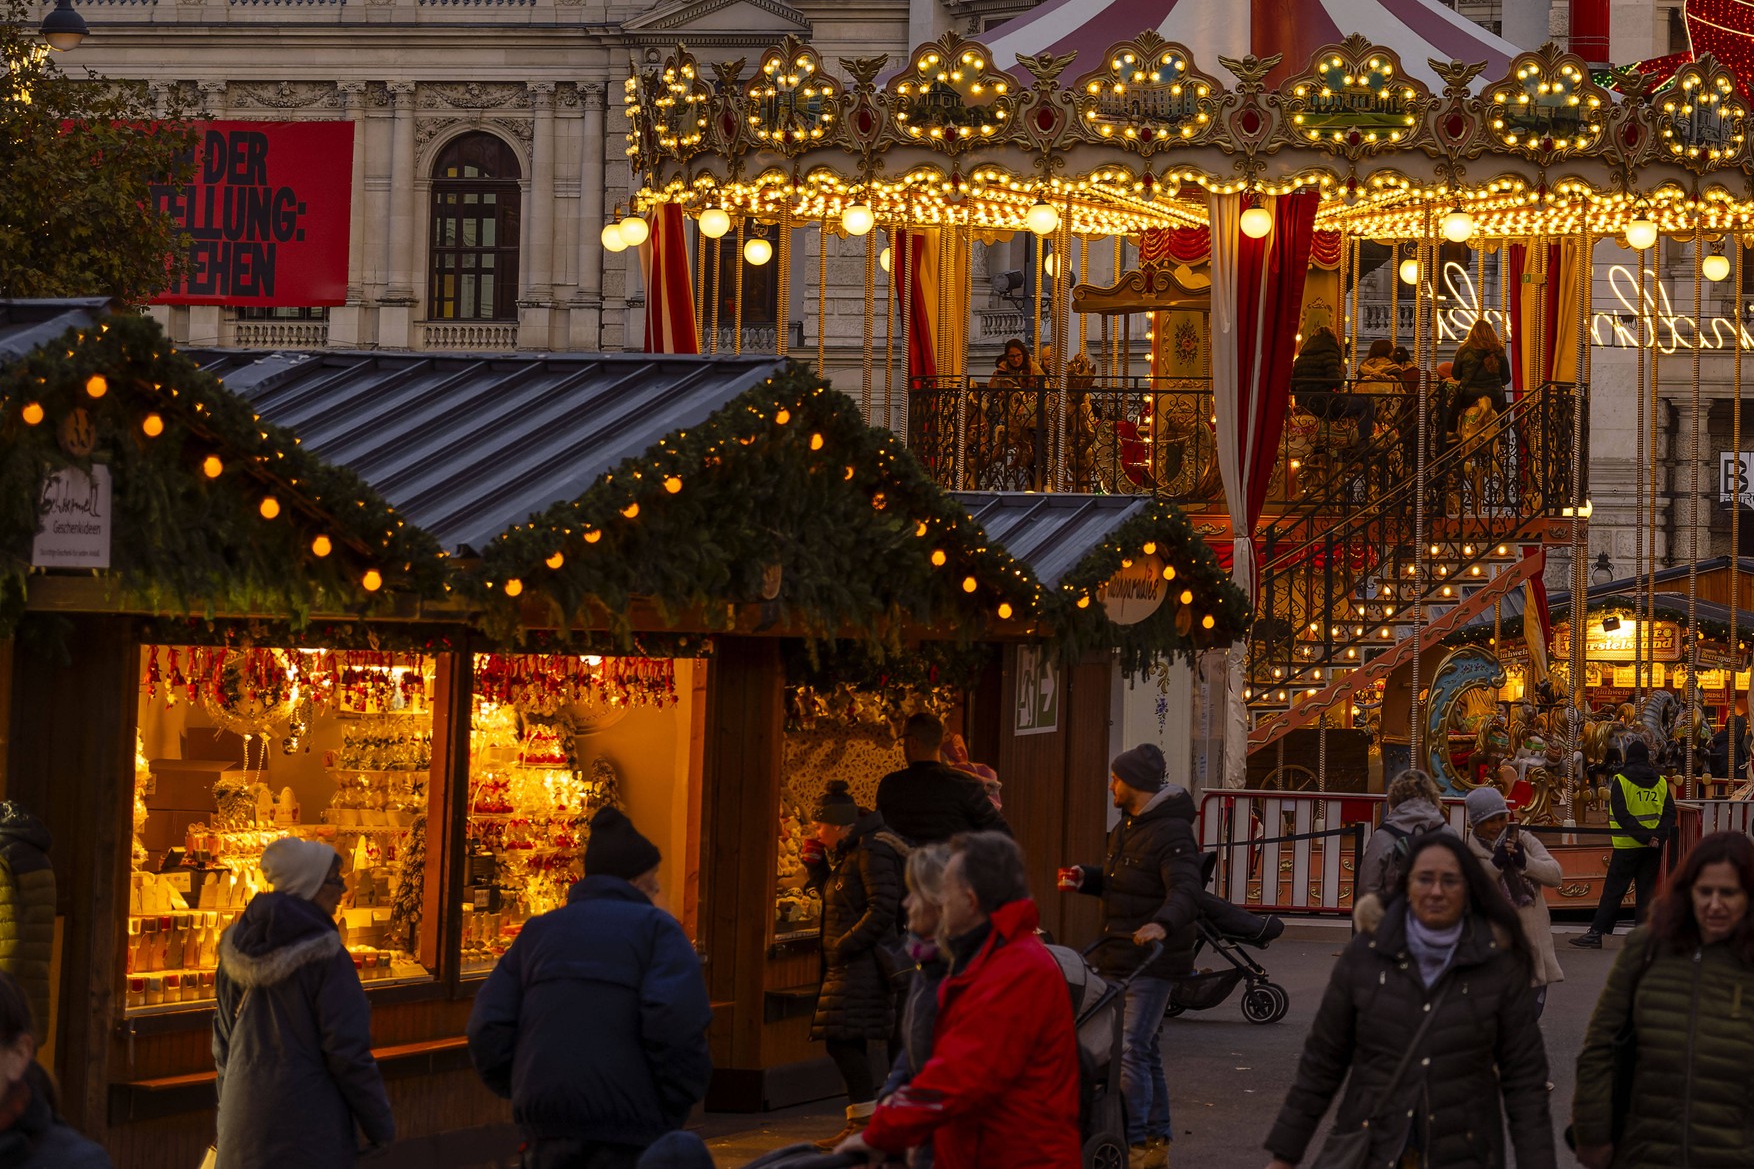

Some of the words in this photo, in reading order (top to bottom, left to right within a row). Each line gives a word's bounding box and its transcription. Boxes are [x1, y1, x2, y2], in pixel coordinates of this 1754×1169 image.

[203, 130, 269, 186] DER
[148, 185, 306, 242] TELLUNG:
[1636, 790, 1659, 804] 172
